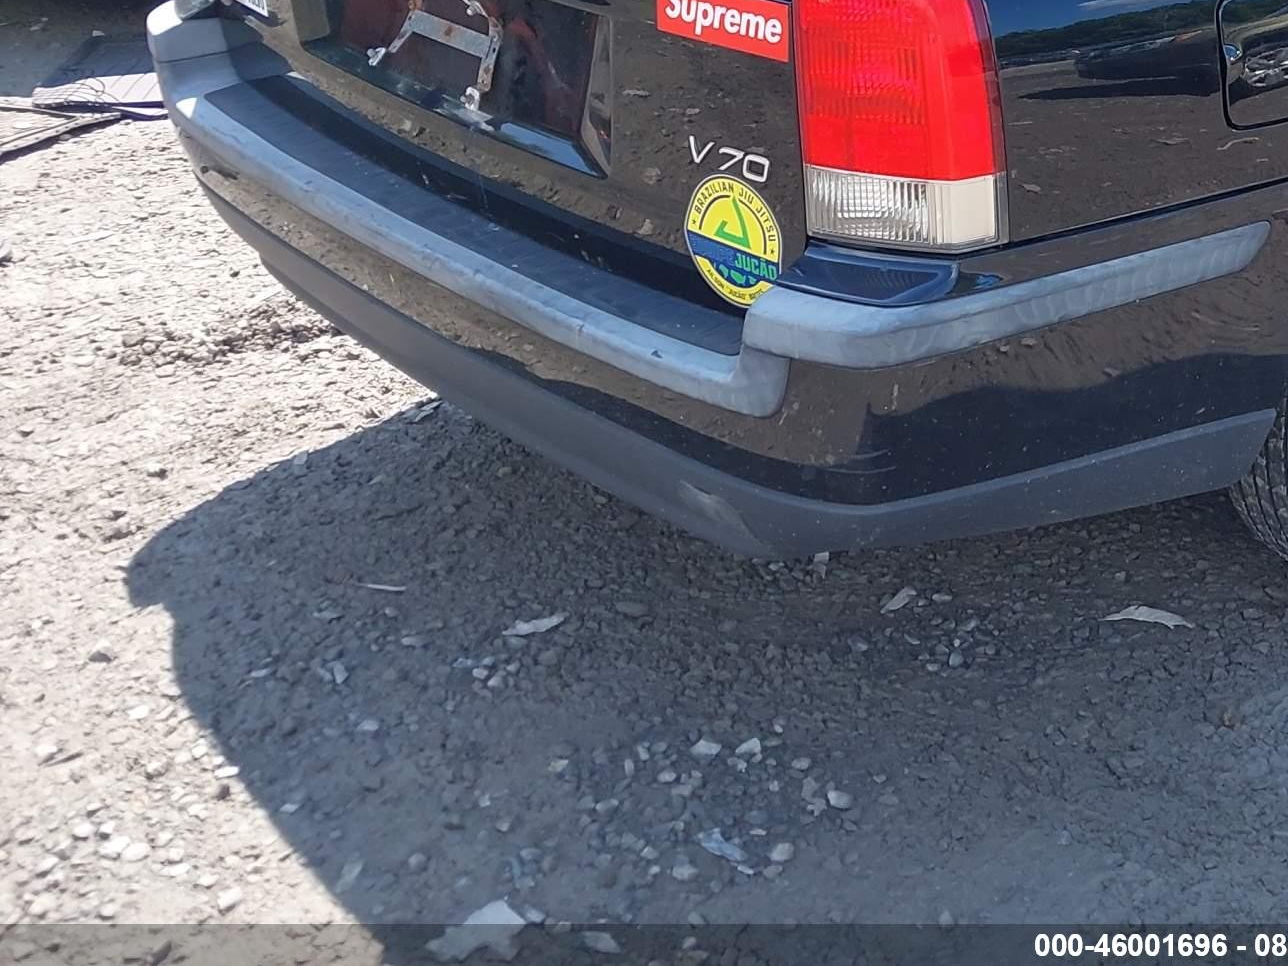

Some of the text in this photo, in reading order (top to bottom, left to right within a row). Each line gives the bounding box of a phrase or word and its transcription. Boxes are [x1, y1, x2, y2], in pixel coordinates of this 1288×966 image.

[688, 134, 770, 183] V70
[693, 181, 777, 242] BRAZILIAN JIU JITSU
